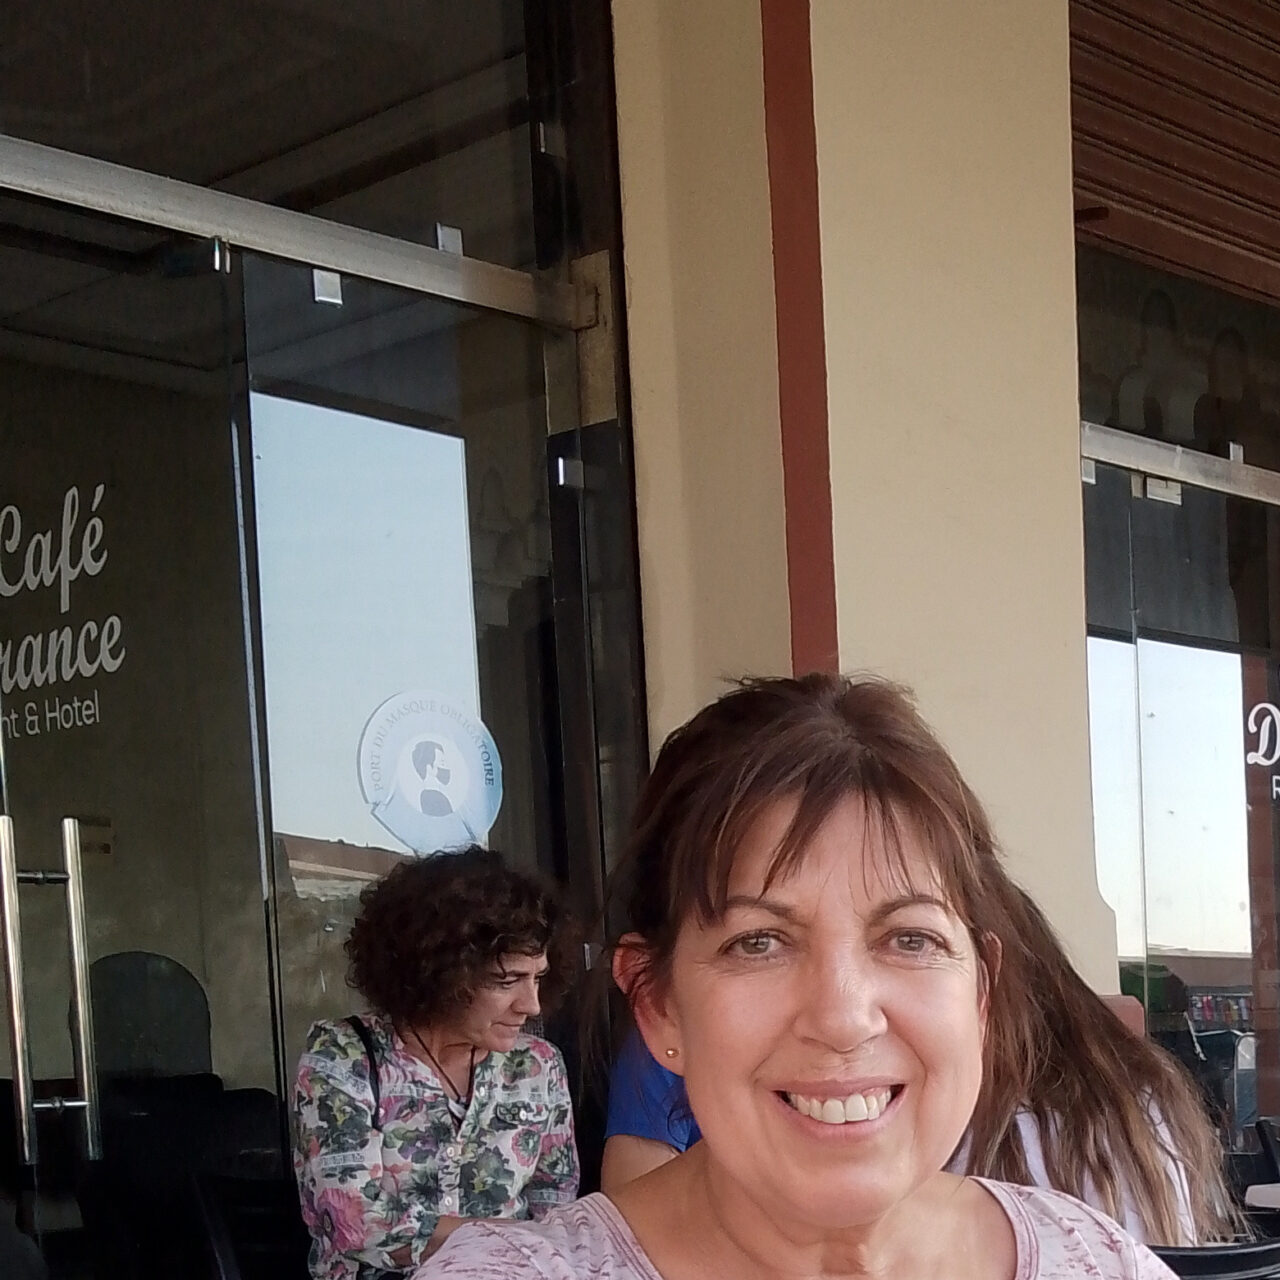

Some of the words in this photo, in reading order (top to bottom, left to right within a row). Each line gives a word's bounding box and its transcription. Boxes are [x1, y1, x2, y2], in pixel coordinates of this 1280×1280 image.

[0, 483, 108, 613] Café
[0, 614, 126, 694] rance
[25, 701, 41, 736] &
[45, 688, 101, 732] Hotel
